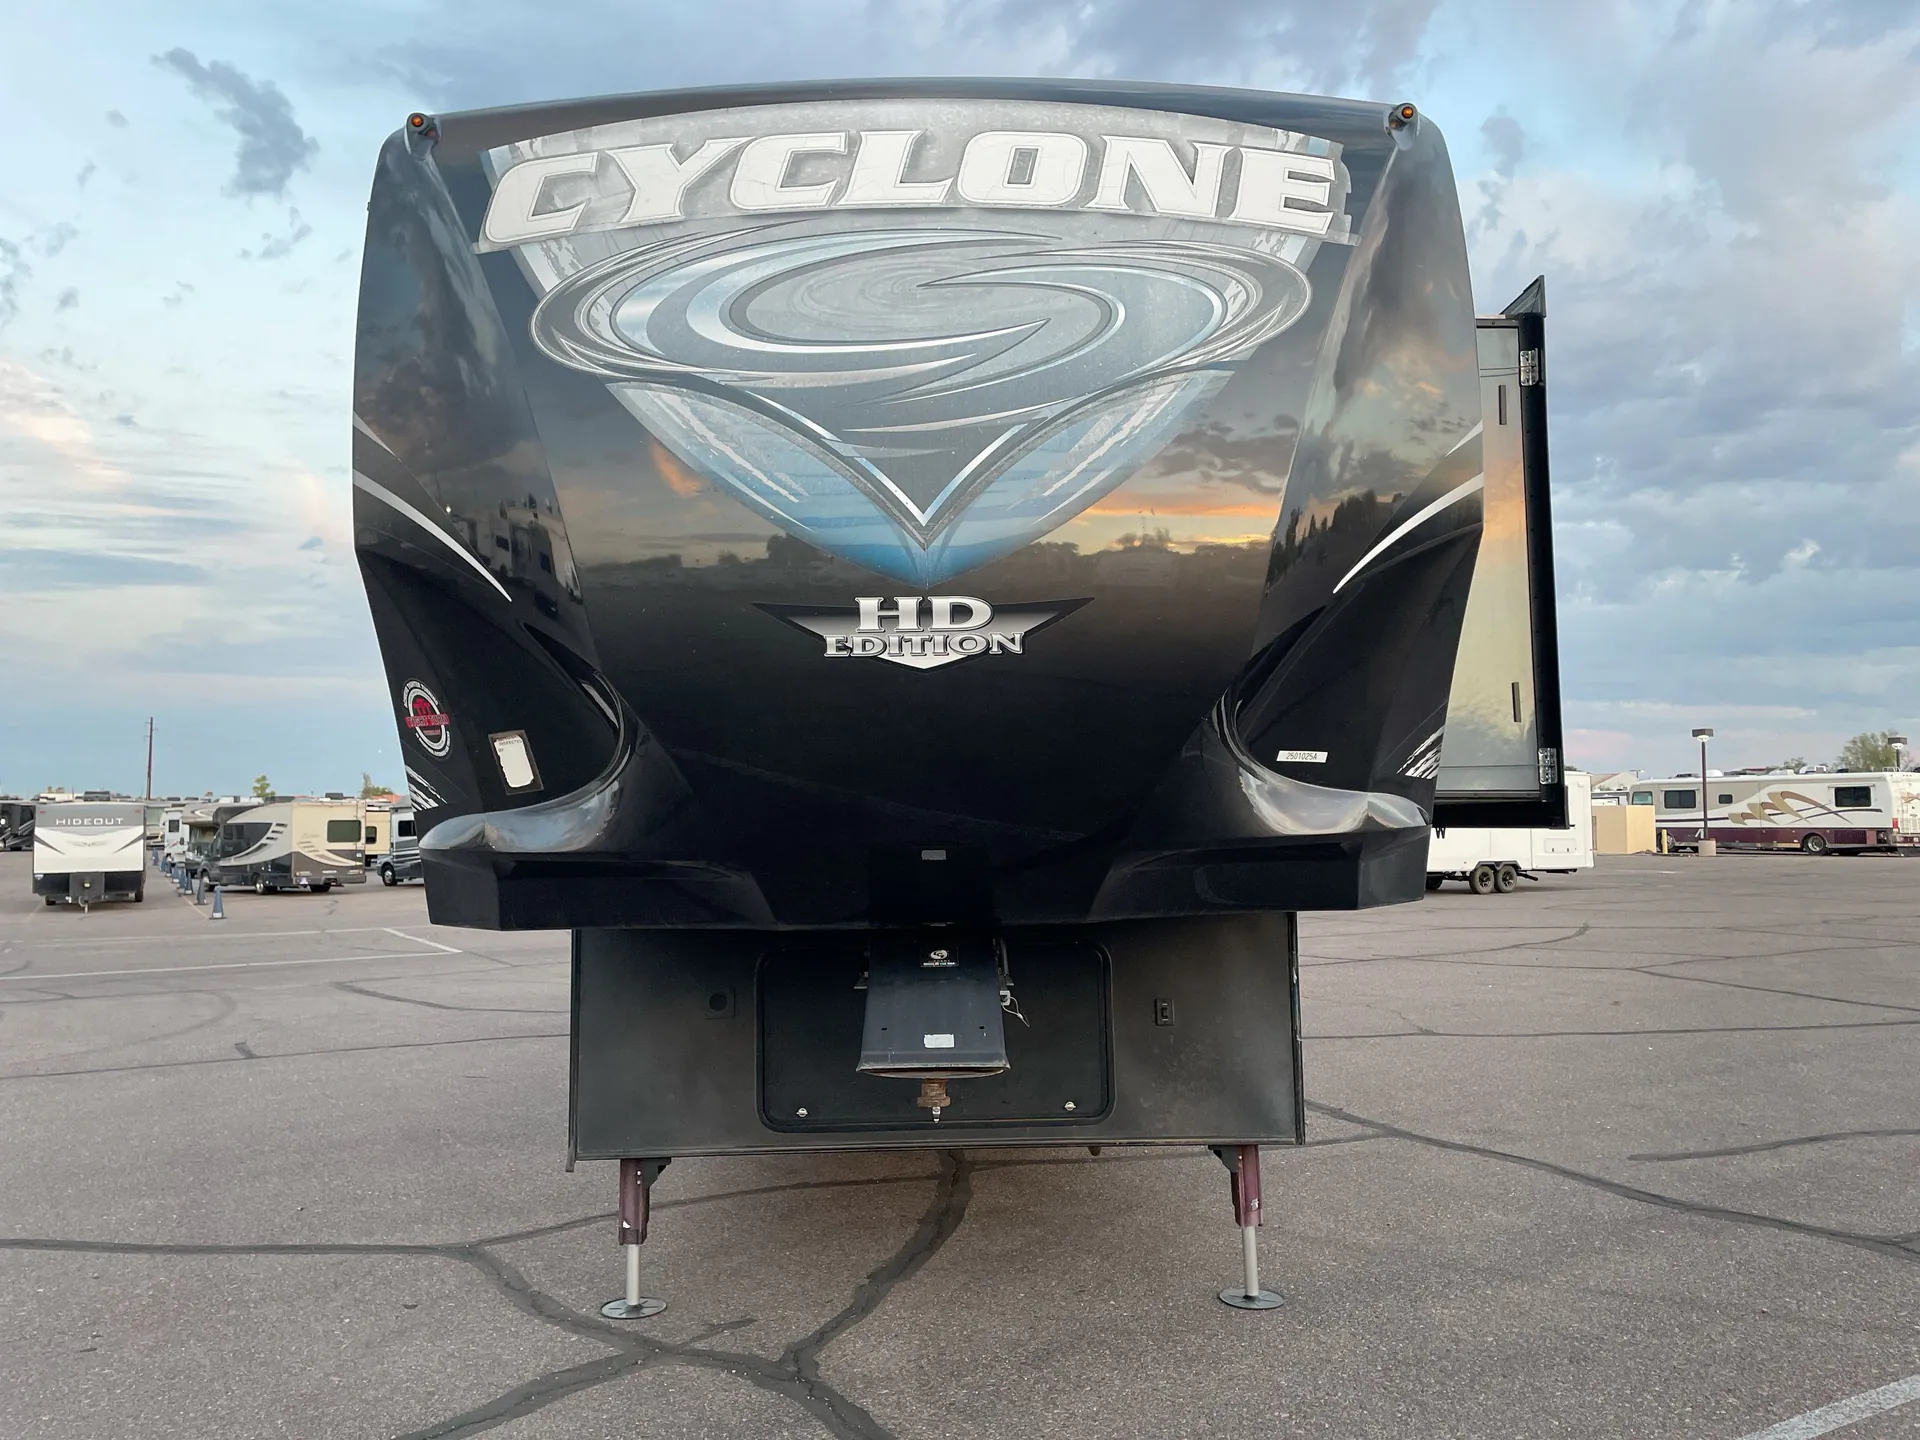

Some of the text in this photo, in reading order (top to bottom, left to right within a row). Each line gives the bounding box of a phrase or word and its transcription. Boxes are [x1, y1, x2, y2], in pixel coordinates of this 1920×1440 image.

[485, 130, 1336, 243] CYCLONE
[855, 596, 994, 633] HD
[823, 632, 1024, 658] EDITION
[1286, 752, 1318, 760] 2501025A
[55, 817, 124, 826] HIDEOUT
